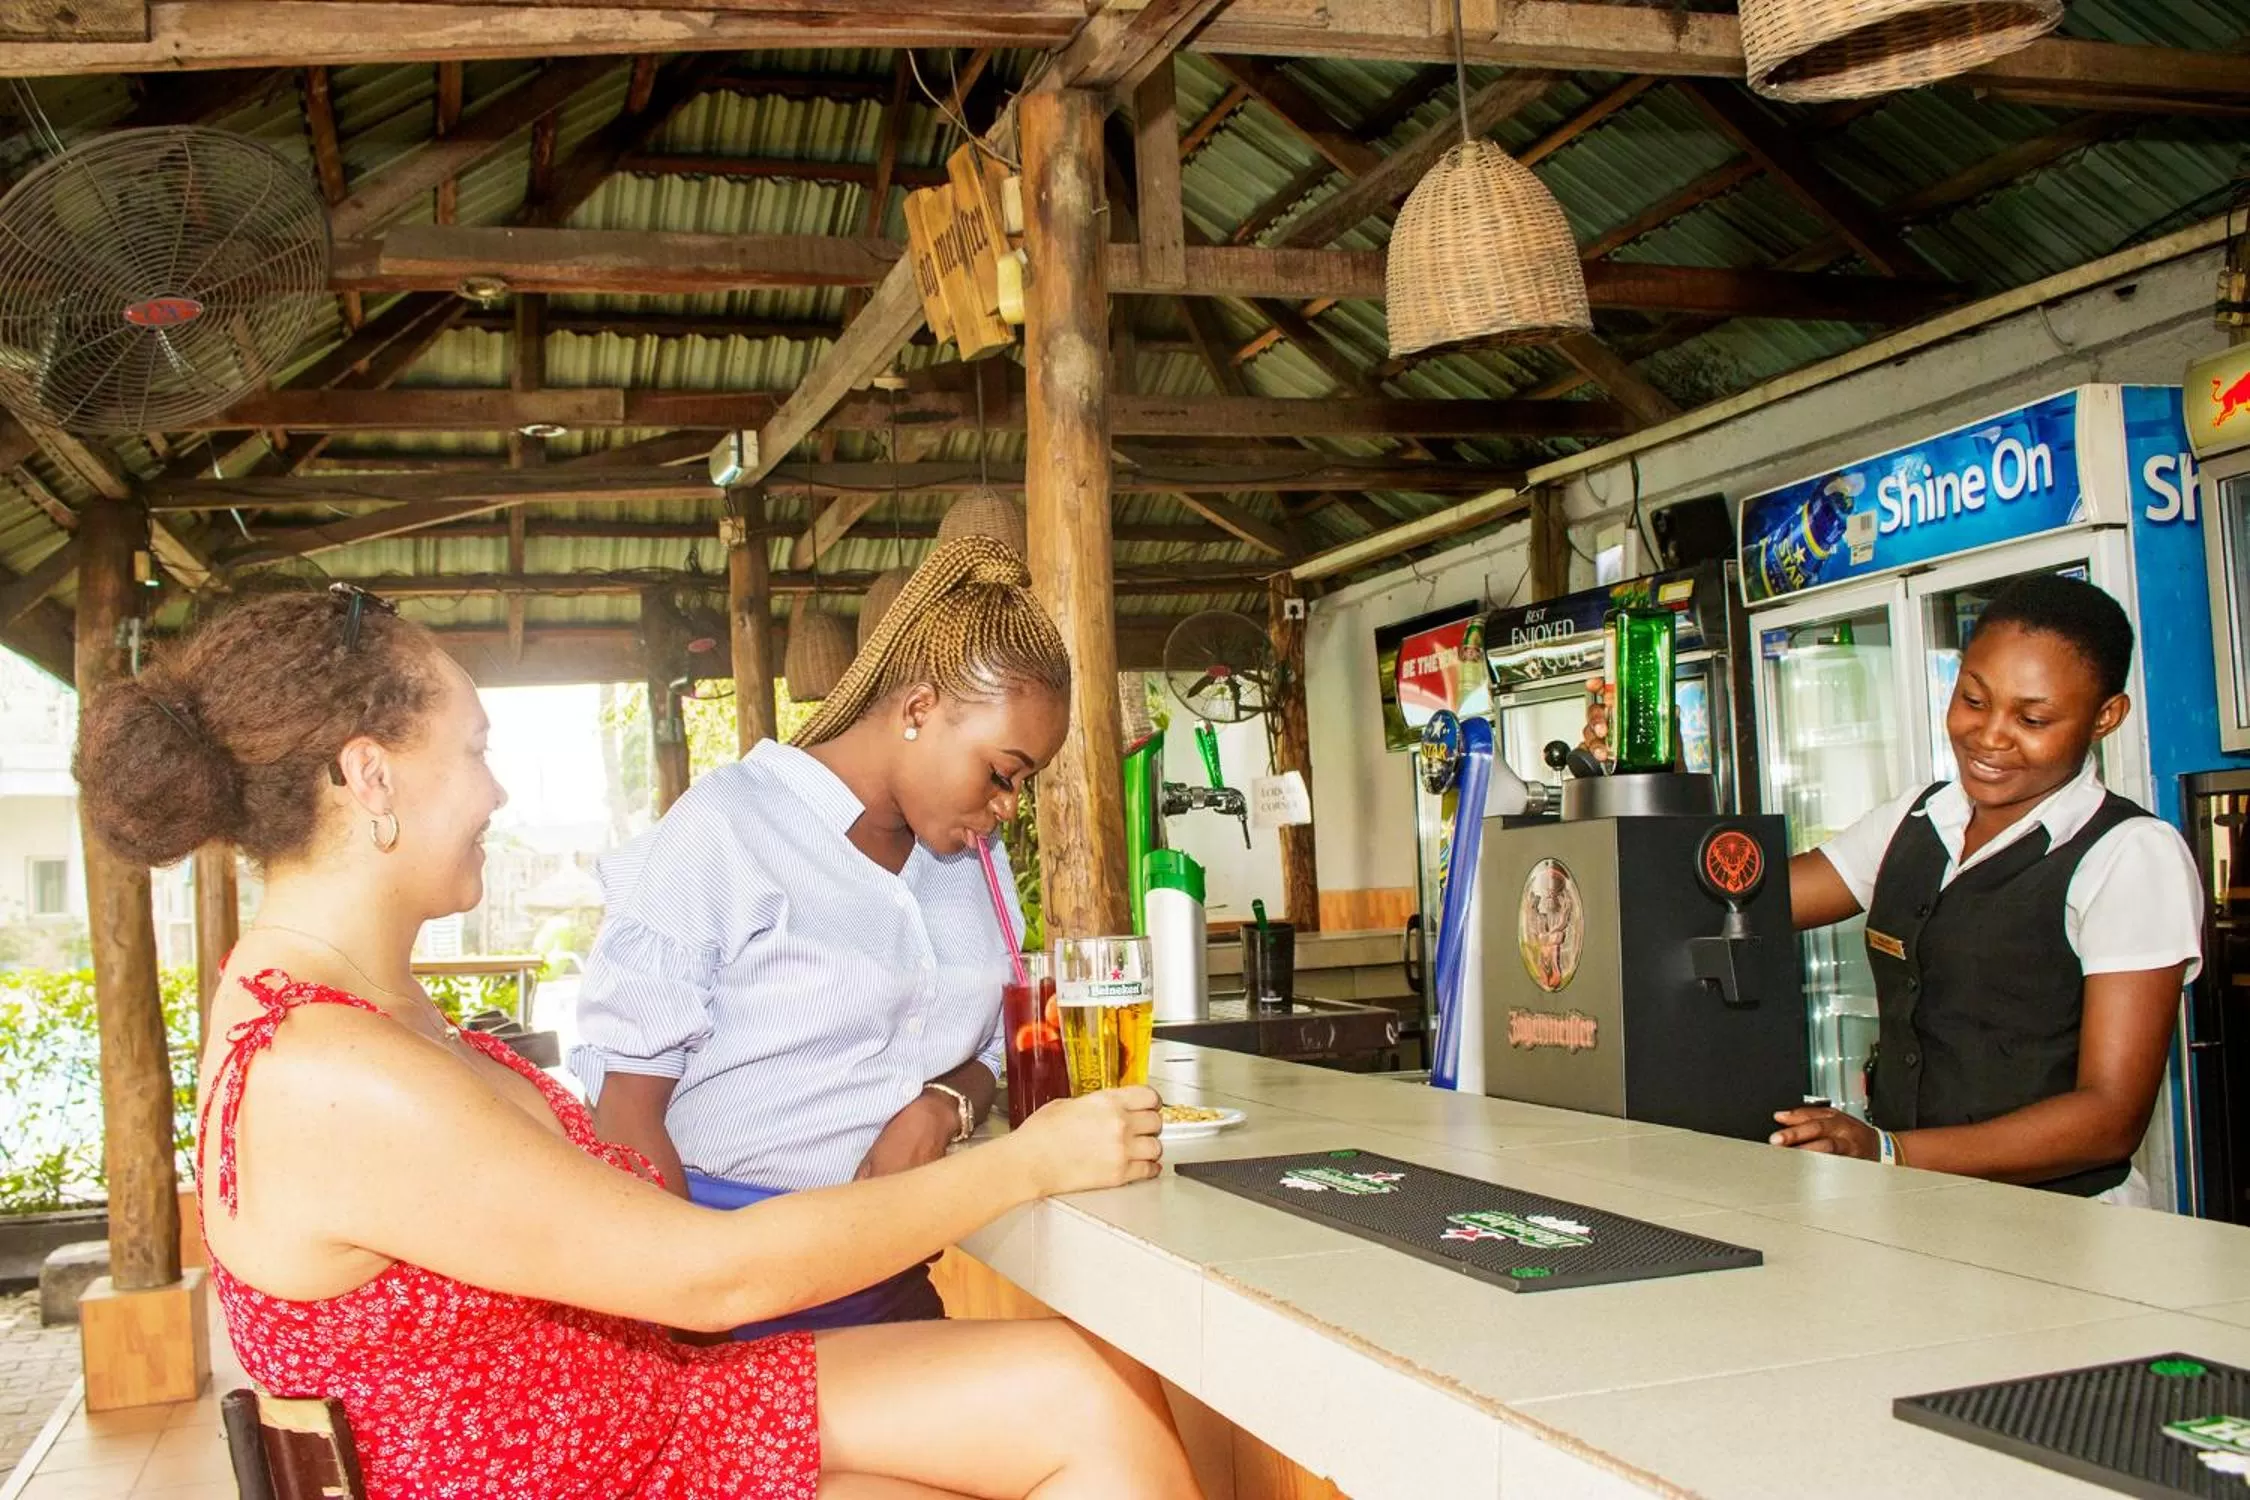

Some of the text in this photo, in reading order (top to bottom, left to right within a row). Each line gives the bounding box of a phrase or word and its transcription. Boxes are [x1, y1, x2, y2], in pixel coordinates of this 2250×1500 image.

[1877, 438, 2053, 534] Shine On
[1524, 607, 1548, 625] BEST
[1511, 618, 1575, 650] ENJOYED
[1402, 658, 1417, 679] BE
[1417, 654, 1438, 676] THE
